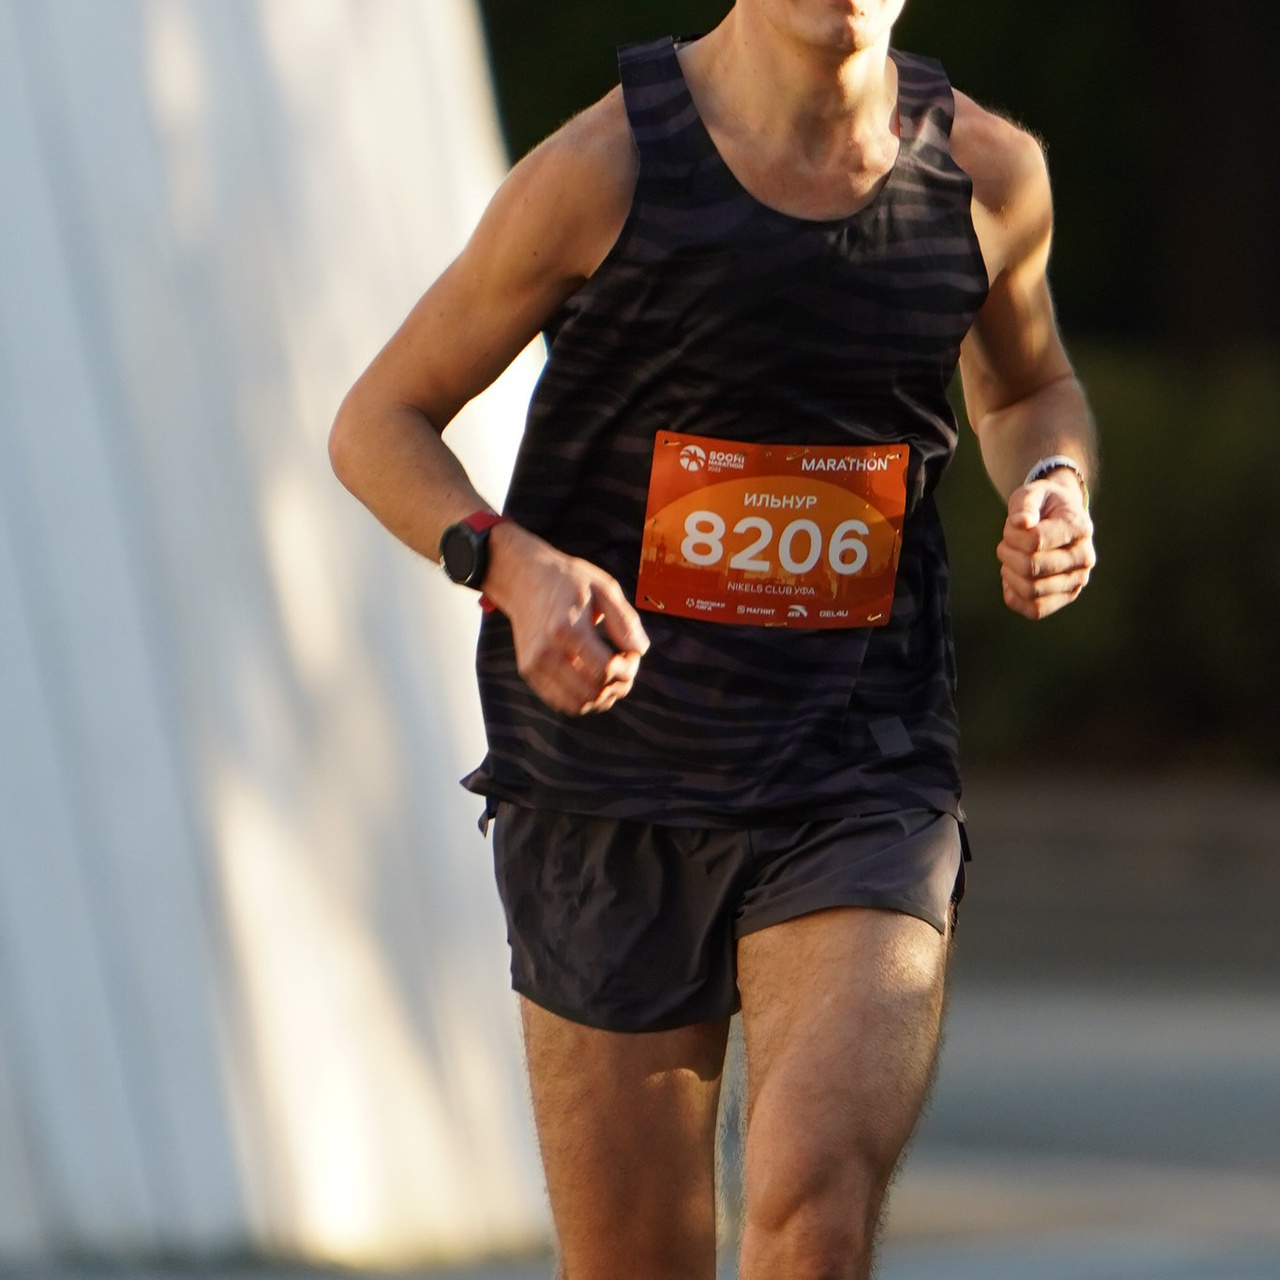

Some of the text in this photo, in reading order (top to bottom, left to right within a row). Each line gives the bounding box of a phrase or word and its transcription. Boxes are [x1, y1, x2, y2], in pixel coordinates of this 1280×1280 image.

[802, 458, 888, 471] MARATHON
[744, 492, 817, 509] ИЛЬНУР
[680, 510, 869, 575] 8206
[727, 581, 815, 596] NIKELS CLUB УФА
